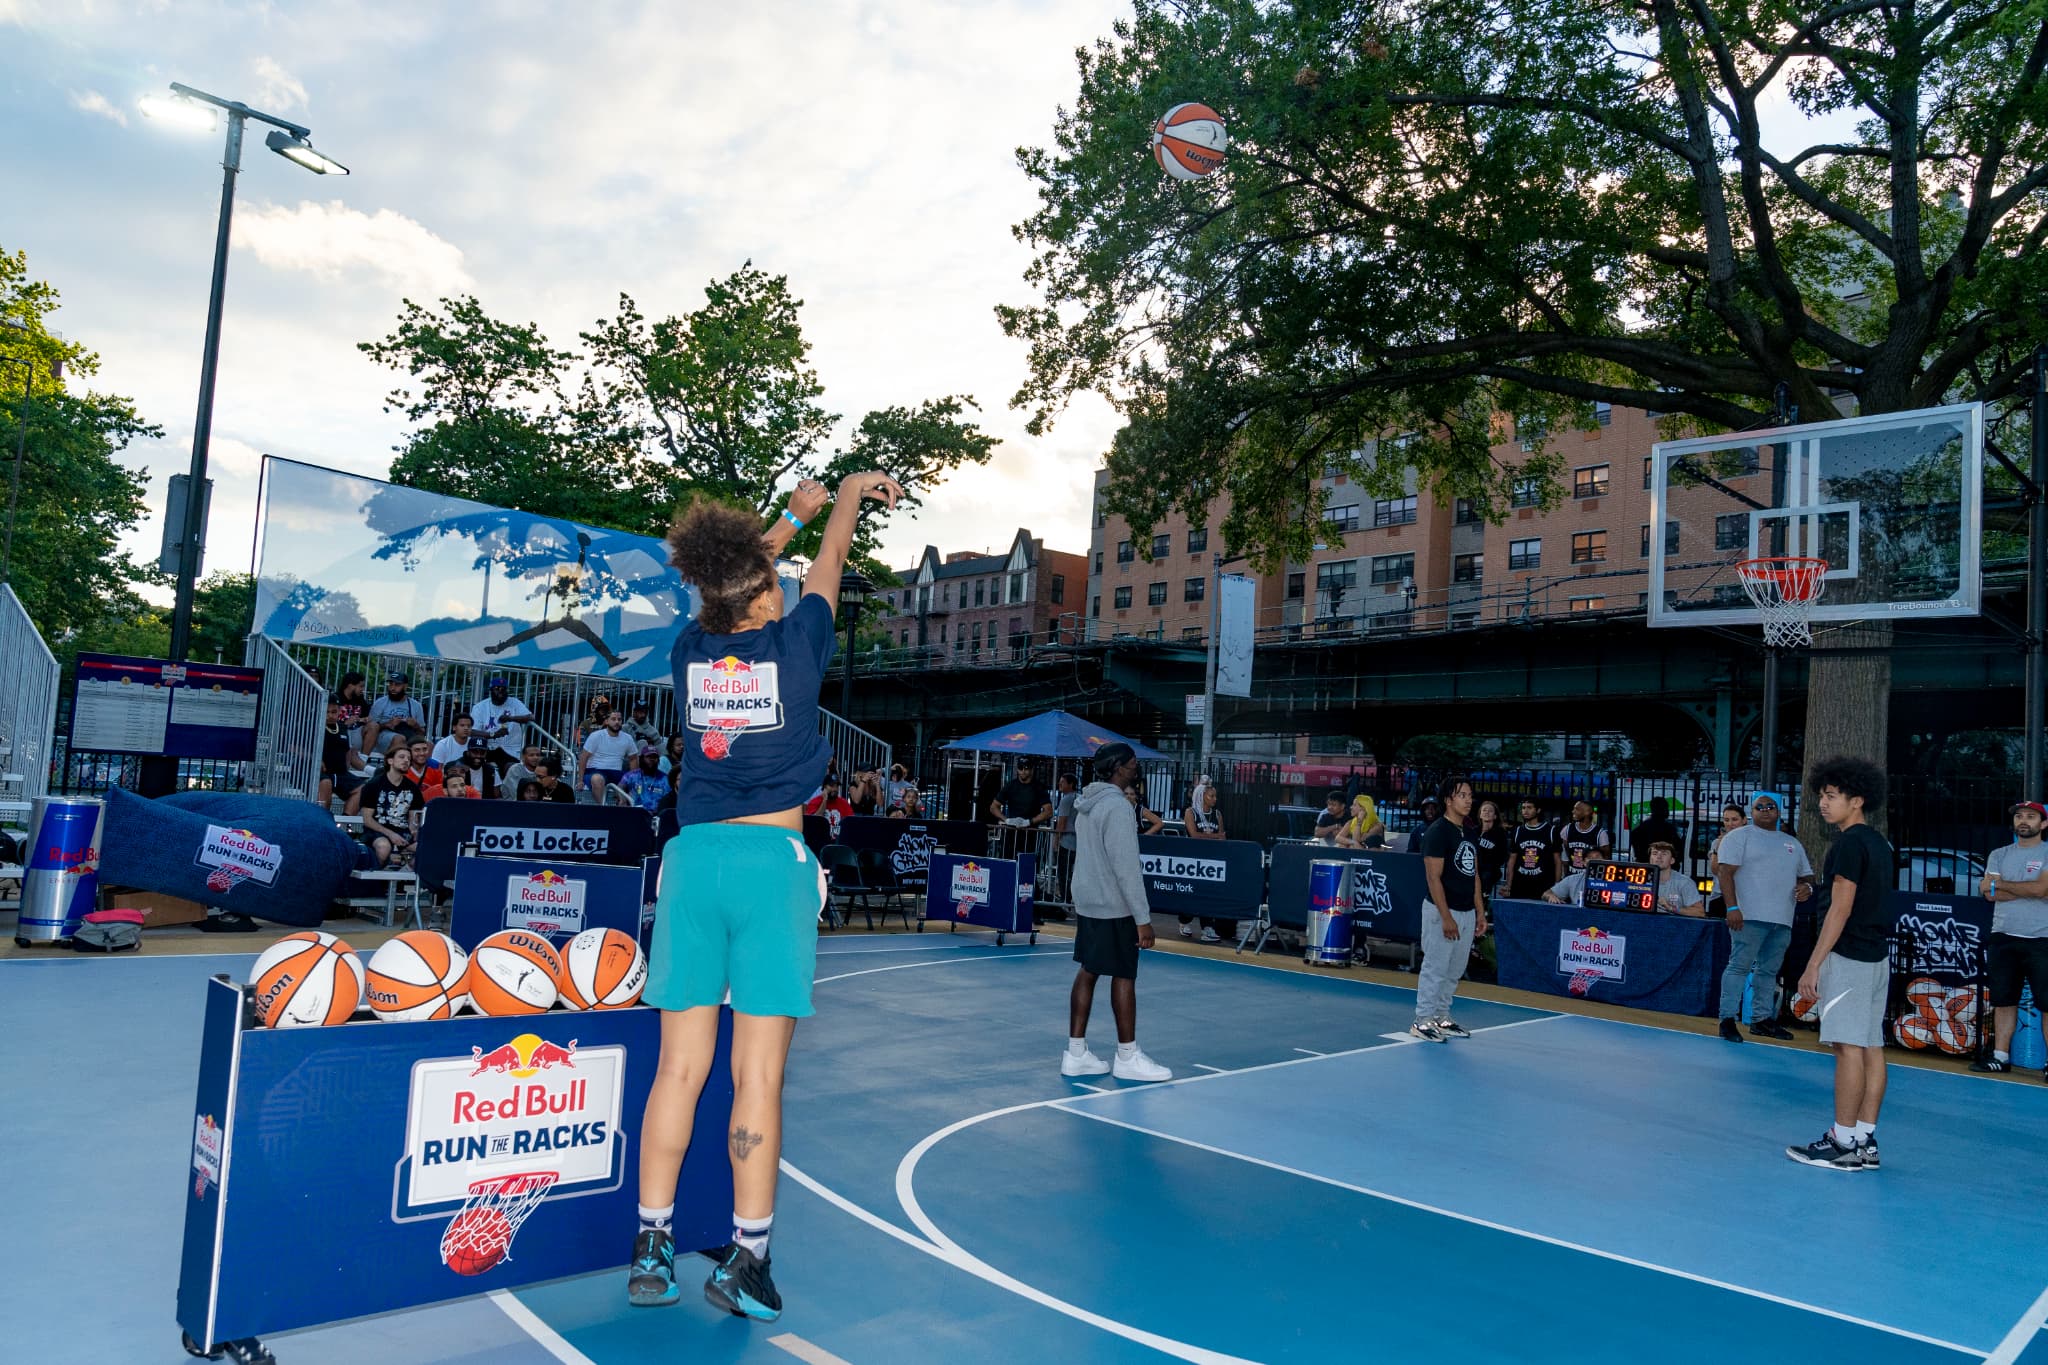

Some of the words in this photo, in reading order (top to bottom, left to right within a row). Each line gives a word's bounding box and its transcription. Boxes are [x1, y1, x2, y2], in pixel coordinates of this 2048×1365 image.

[703, 678, 728, 693] Red
[732, 678, 758, 694] Bull
[693, 698, 715, 710] RUN
[726, 698, 771, 710] RACKS
[220, 834, 245, 850] Red
[246, 841, 271, 857] Bull
[476, 829, 524, 850] Foot
[533, 831, 605, 851] Locker
[49, 848, 83, 863] Red
[208, 844, 231, 858] RUN
[239, 853, 275, 871] RACKS
[1168, 858, 1224, 879] Locker
[1605, 865, 1647, 884] 0:40
[1154, 880, 1173, 891] New
[1175, 883, 1195, 894] York
[521, 887, 546, 902] Red
[547, 890, 571, 904] Bull
[1335, 897, 1352, 909] Bull
[1642, 893, 1653, 908] 0
[511, 904, 534, 916] RUN
[542, 906, 579, 918] RACKS
[1572, 940, 1592, 953] Red
[1593, 943, 1613, 955] Bull
[509, 935, 560, 977] Wilson
[1563, 953, 1582, 963] RUN
[1589, 956, 1620, 967] RACKS
[453, 1085, 520, 1124] Red
[525, 1079, 586, 1117] Bull
[422, 1135, 488, 1166] RUN
[491, 1136, 510, 1154] THE
[513, 1121, 606, 1155] RACKS
